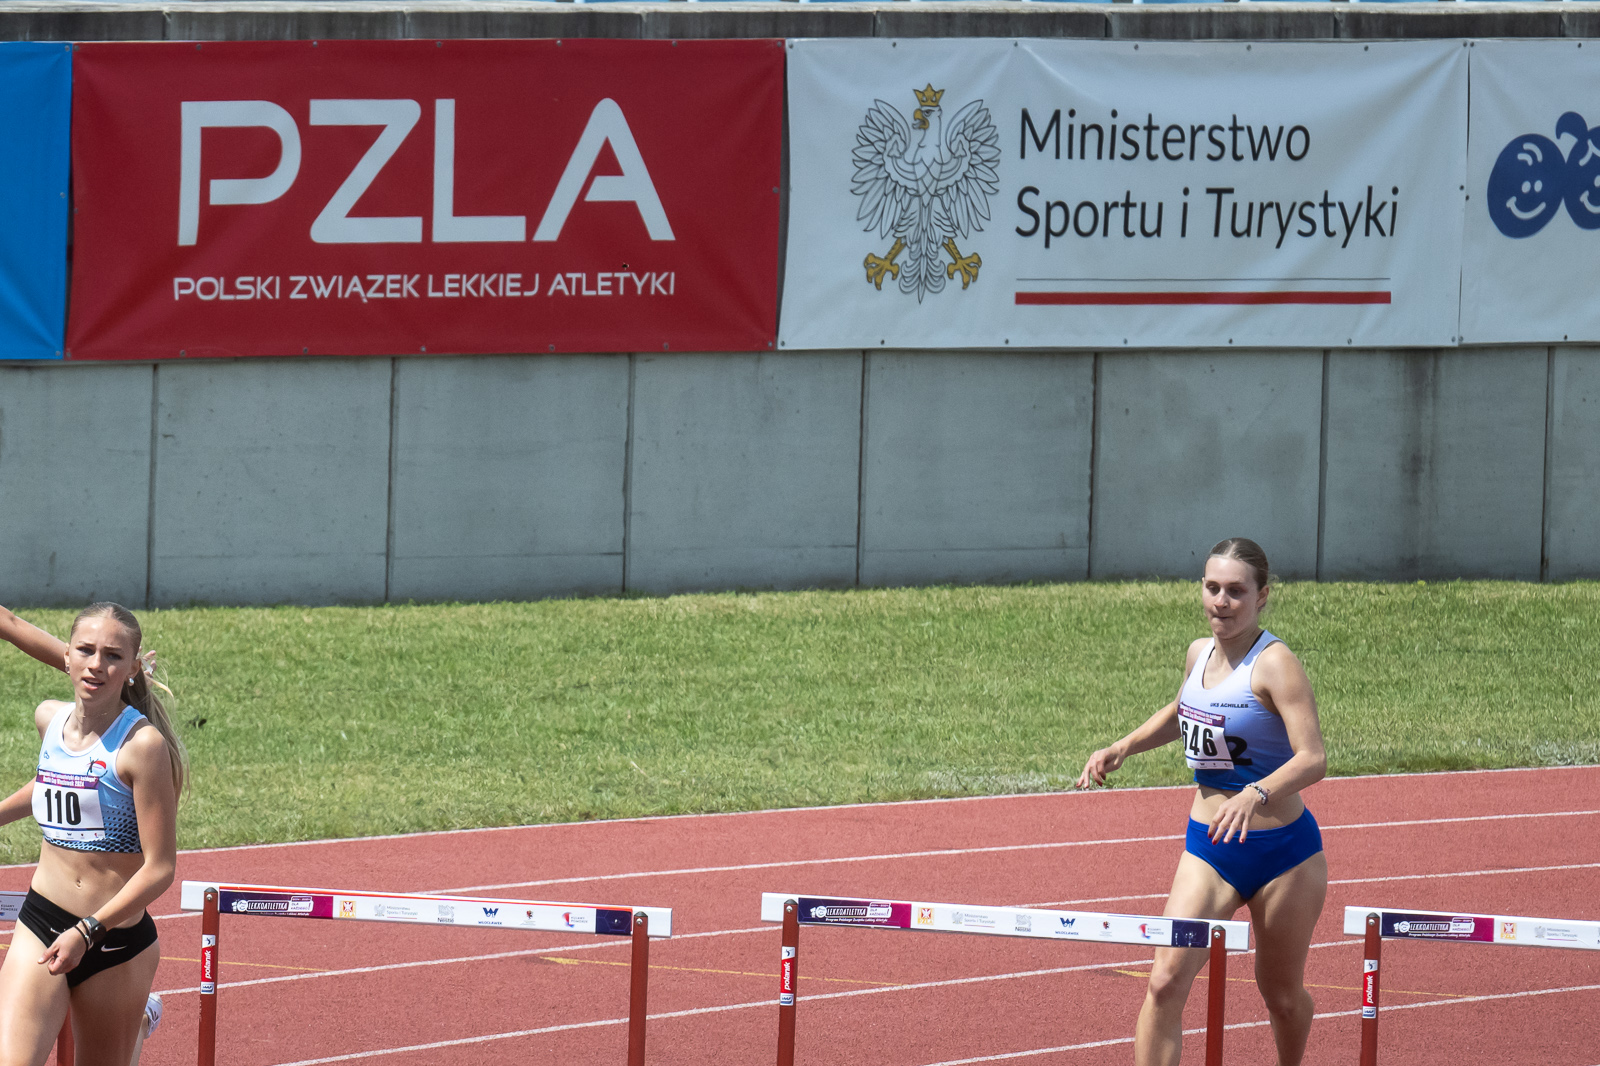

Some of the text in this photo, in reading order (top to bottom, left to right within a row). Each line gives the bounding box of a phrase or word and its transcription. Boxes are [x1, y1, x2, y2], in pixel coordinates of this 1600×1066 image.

[1019, 107, 1311, 162] Ministerstwo
[177, 97, 676, 246] PZLA
[1014, 185, 1400, 249] Sportu i Turystyki
[173, 271, 675, 303] POLSKI ZWIĄZEK LEKKIEJ ATLETYKI
[1181, 720, 1218, 756] 646
[45, 788, 82, 825] 110
